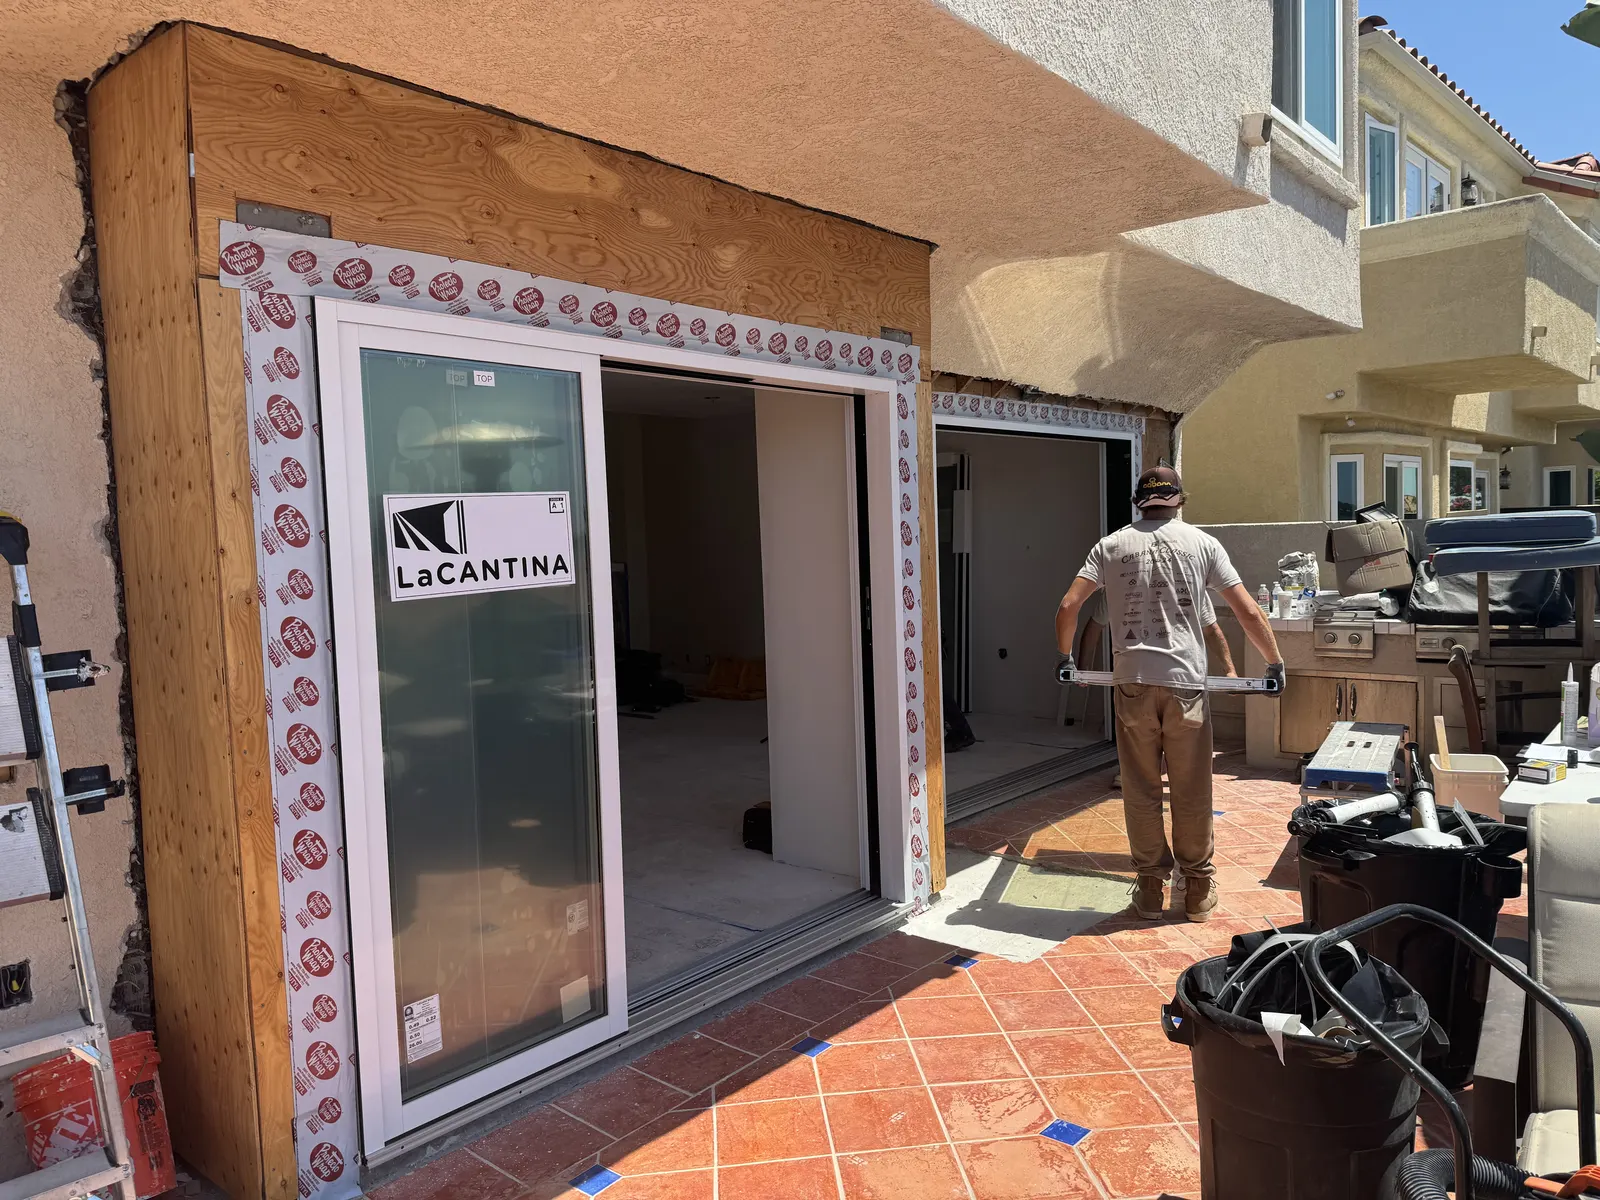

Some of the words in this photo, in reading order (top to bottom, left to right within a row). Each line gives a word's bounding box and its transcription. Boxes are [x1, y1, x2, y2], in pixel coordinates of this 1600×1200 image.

[222, 242, 257, 270] Protecto
[232, 256, 259, 274] Wrap
[335, 259, 366, 284] Protecto
[344, 271, 367, 288] Wrap
[431, 273, 457, 297] Protecto
[438, 285, 459, 300] Wrap
[261, 296, 281, 321] Wrap
[271, 294, 294, 321] rotecto
[515, 287, 539, 310] Protecto
[522, 299, 540, 314] Wrap
[276, 354, 289, 374] Wrap
[277, 348, 298, 373] Protecto
[269, 405, 288, 432] Wrap
[272, 397, 301, 431] Protecto
[282, 464, 296, 483] Wrap
[284, 459, 305, 483] Protecto
[276, 514, 295, 540] Wrap
[279, 506, 308, 540] Protecto
[291, 570, 312, 594] Protecto
[397, 554, 569, 589] LaCANTINA
[289, 576, 303, 595] Wrap
[283, 626, 302, 651] Wrap
[285, 618, 314, 651] Protecto
[295, 684, 309, 701] Wrap
[297, 678, 318, 701] Protecto
[289, 733, 307, 758] Wrap
[292, 725, 320, 757] Protecto
[302, 789, 315, 806] Wrap
[303, 784, 324, 806] Protecto
[295, 839, 314, 863] Wrap
[298, 831, 326, 862] Protecto
[308, 898, 321, 914] Wrap
[310, 892, 330, 914] Protecto
[302, 947, 320, 970] Wrap
[304, 940, 332, 970] Protecto
[314, 1001, 327, 1017] Wrap
[316, 995, 336, 1017] Protecto
[308, 1050, 326, 1073] Wrap
[310, 1043, 338, 1073] Protecto
[312, 1152, 330, 1175] Wrap
[314, 1144, 342, 1175] Protecto
